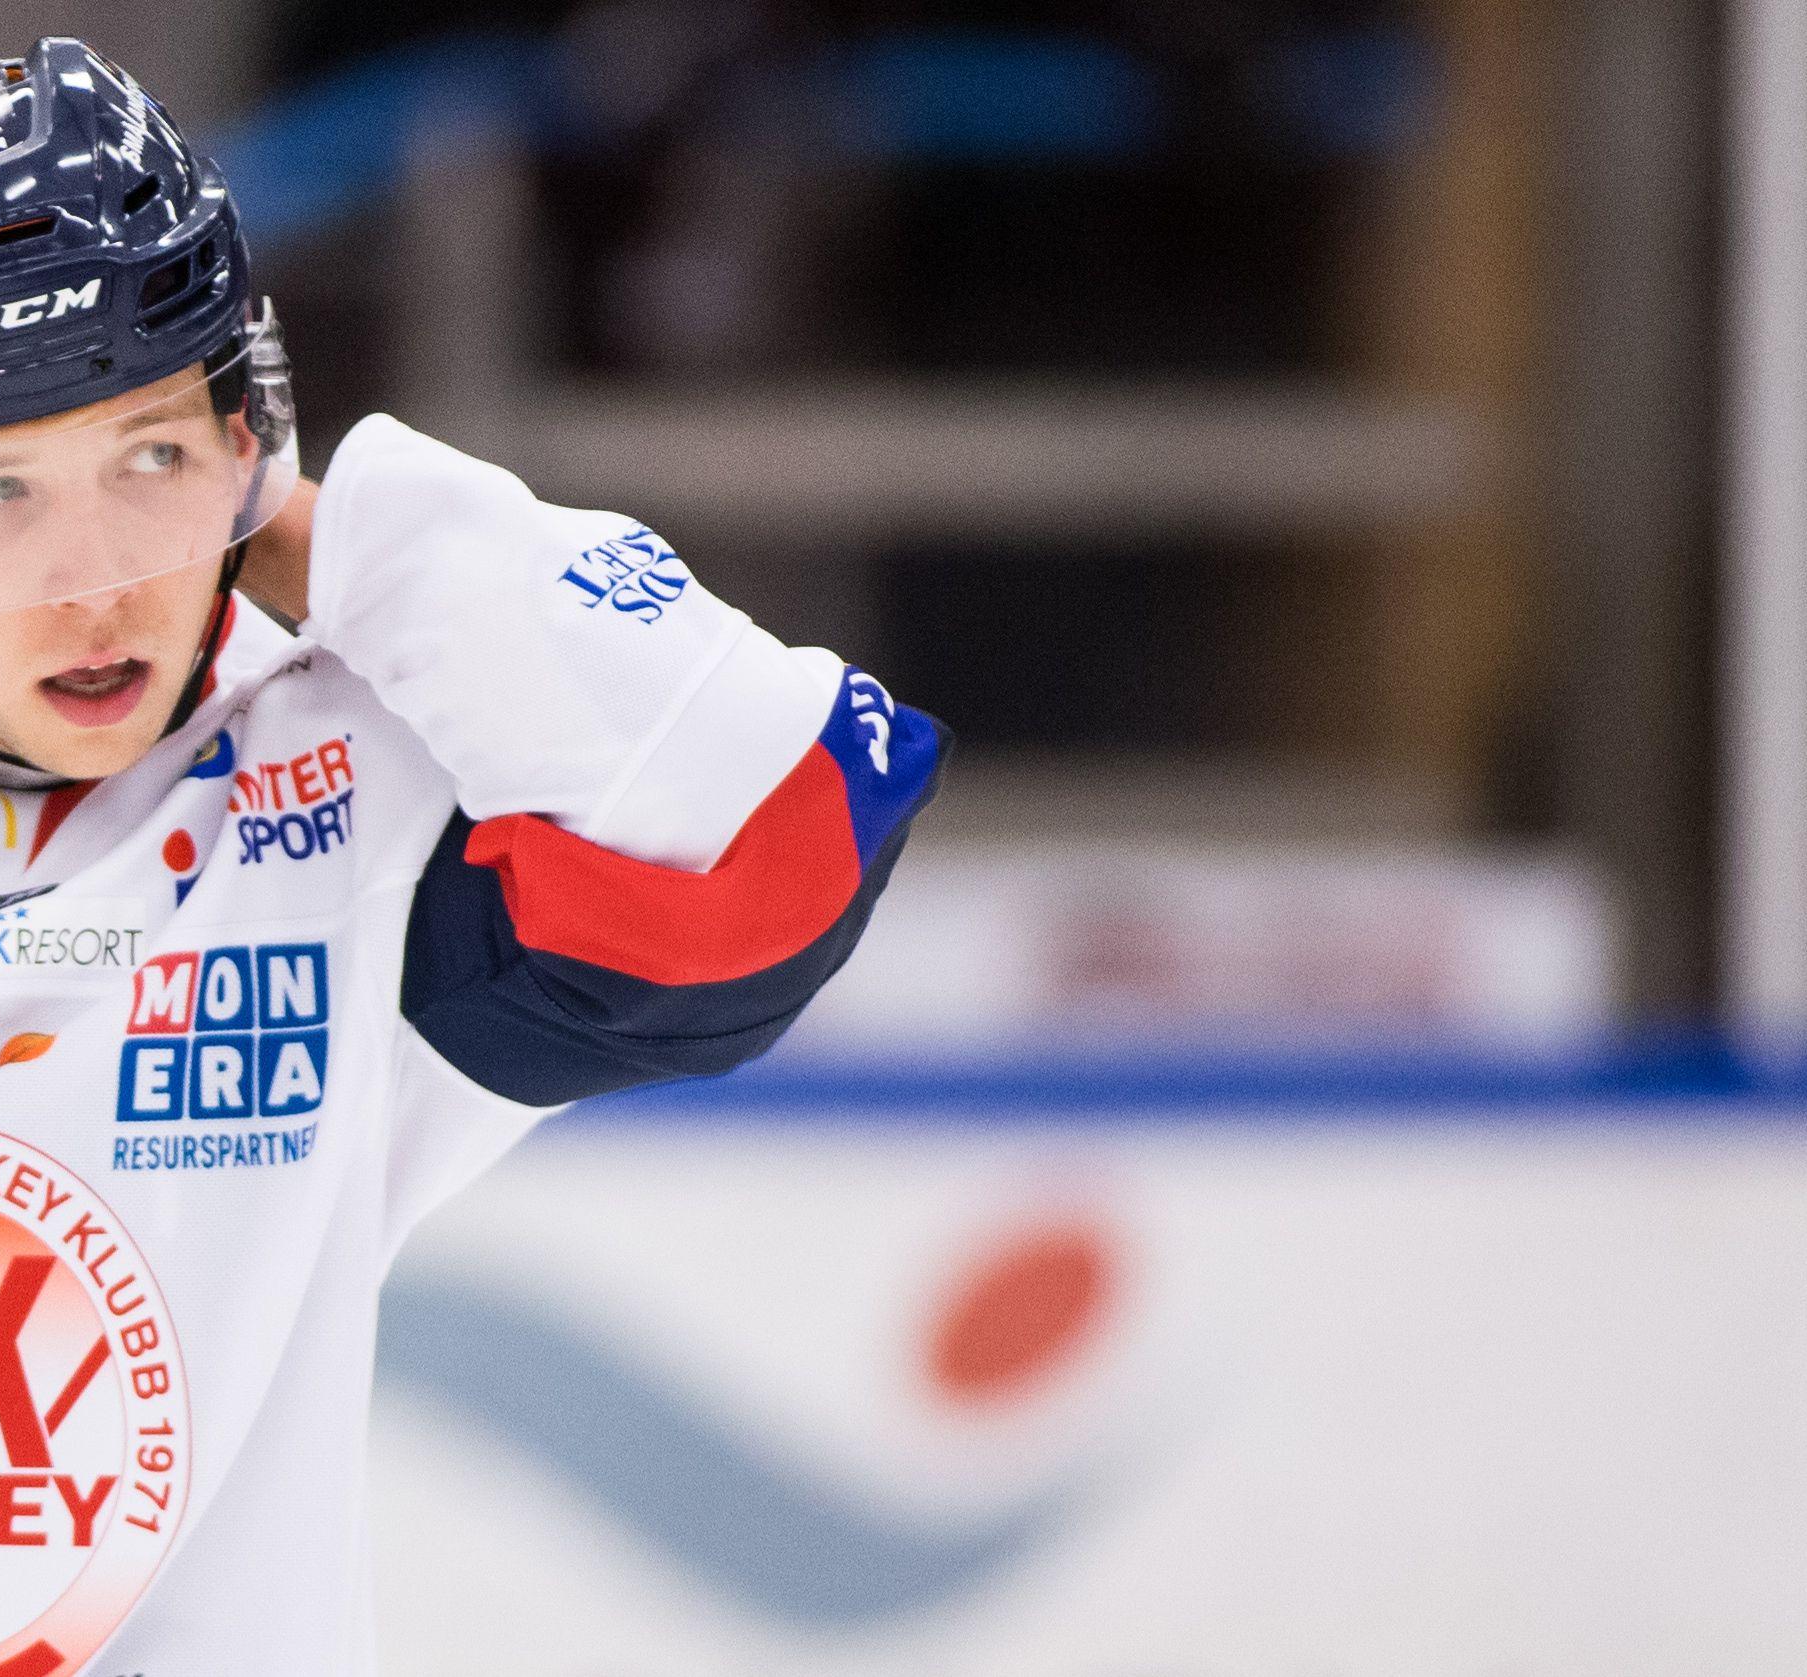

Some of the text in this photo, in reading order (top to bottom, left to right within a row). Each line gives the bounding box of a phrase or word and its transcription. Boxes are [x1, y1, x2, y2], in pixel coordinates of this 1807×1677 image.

[238, 788, 355, 866] SPORT
[112, 1121, 319, 1170] RESURSPARTNE
[63, 1210, 171, 1402] KLUBB
[124, 1417, 176, 1535] 1971
